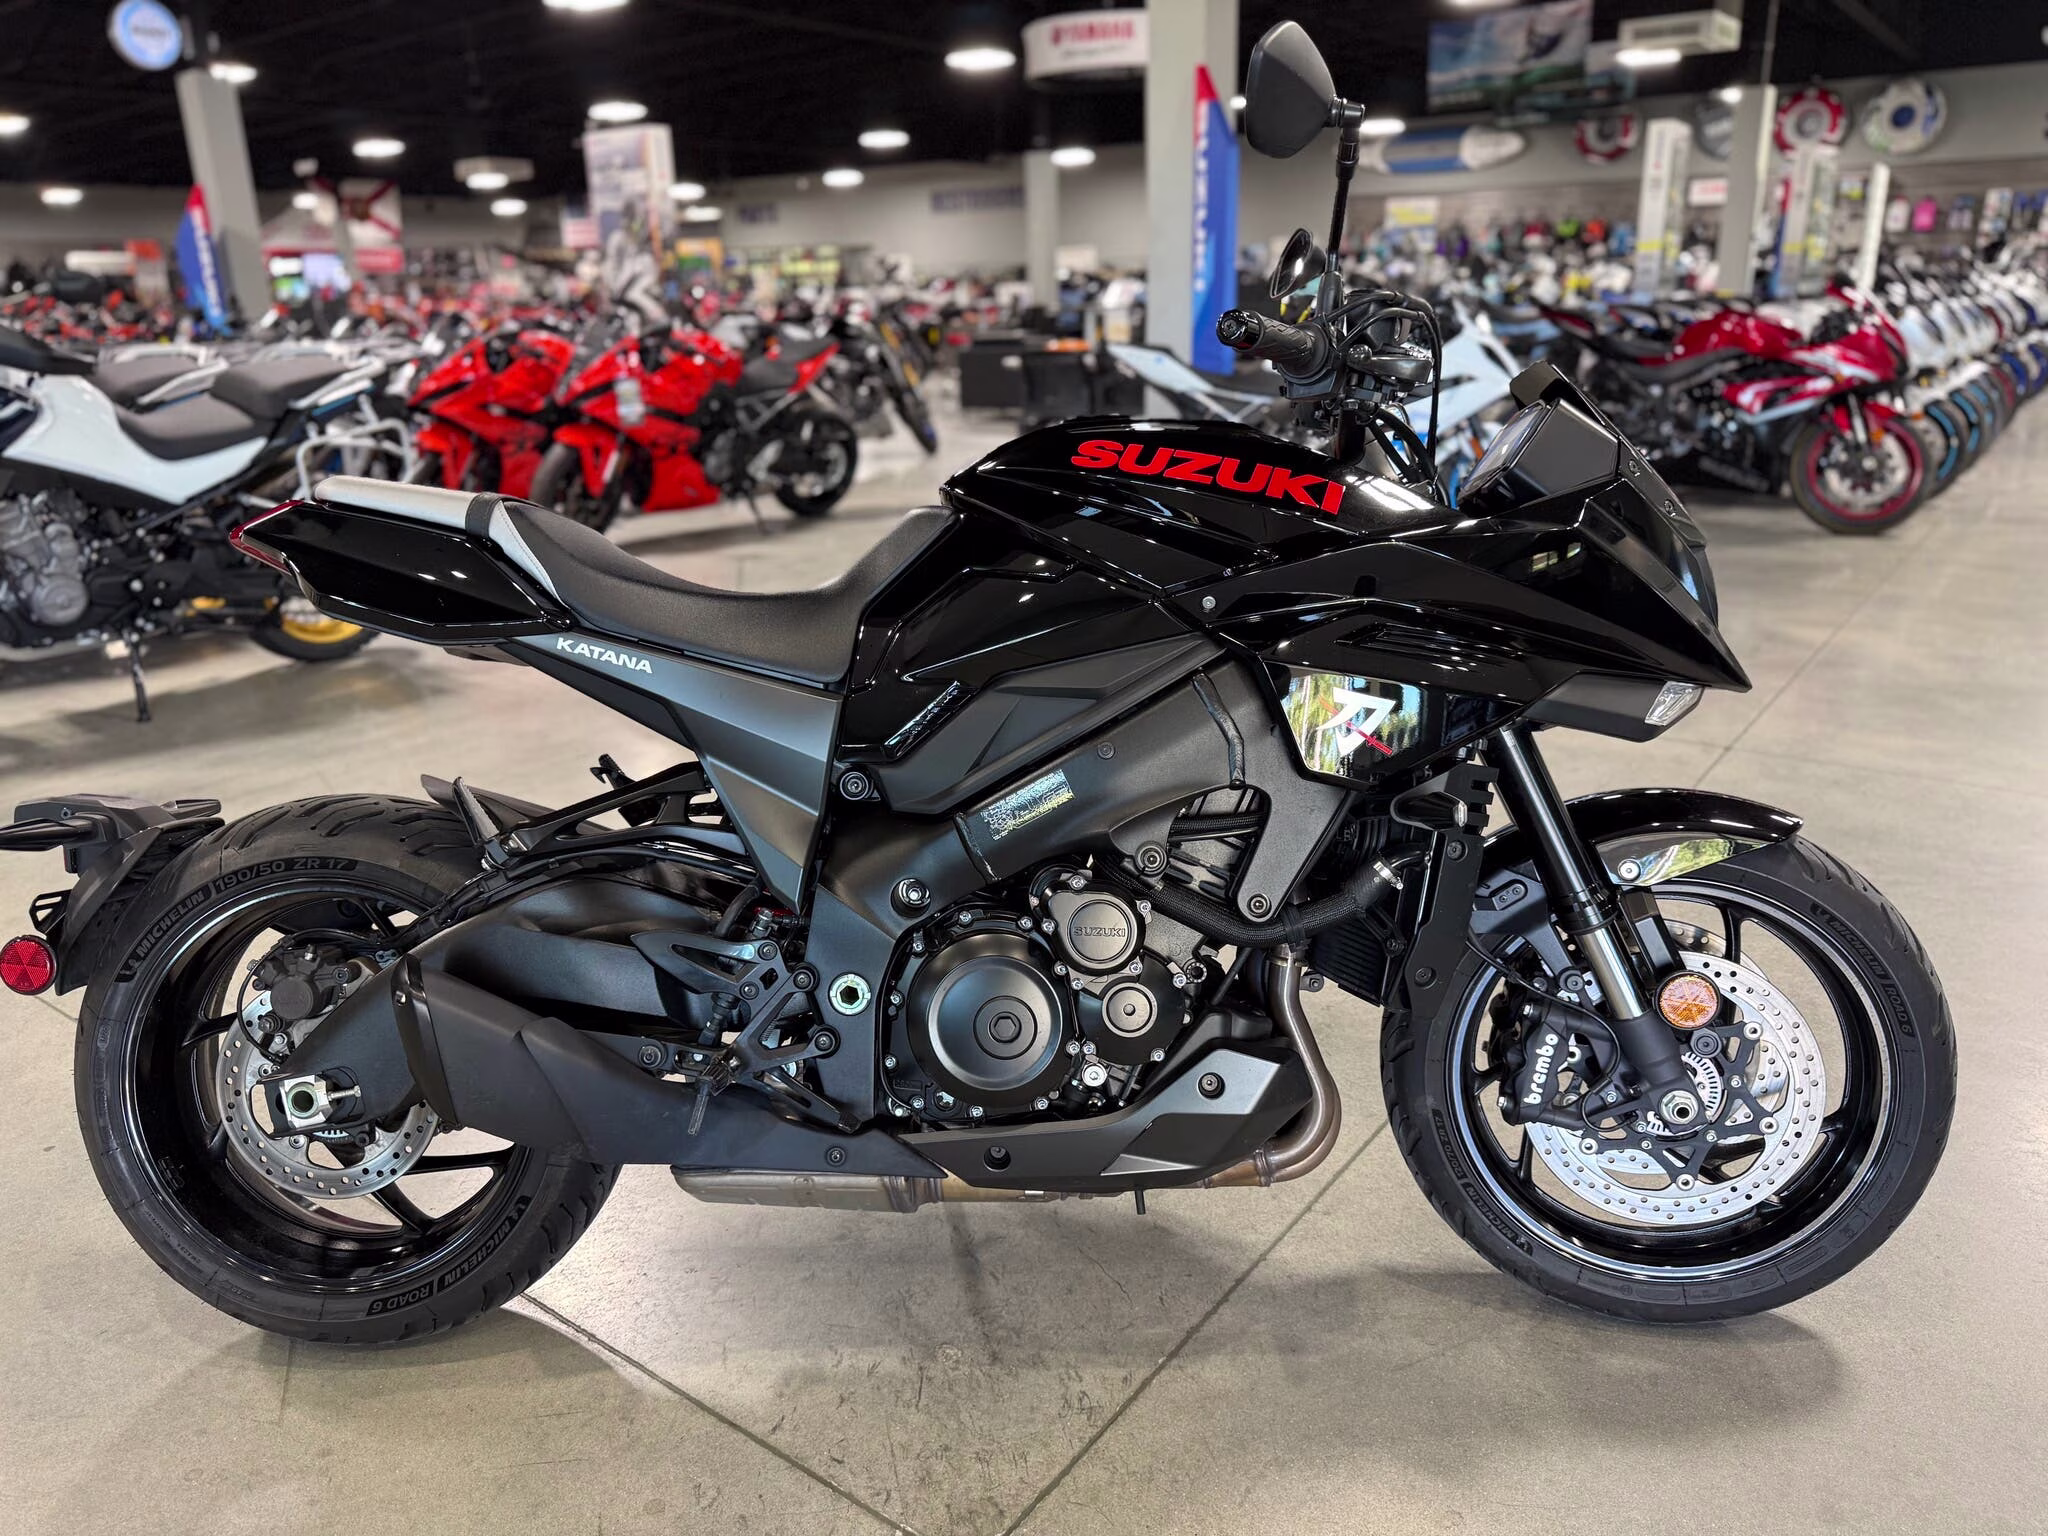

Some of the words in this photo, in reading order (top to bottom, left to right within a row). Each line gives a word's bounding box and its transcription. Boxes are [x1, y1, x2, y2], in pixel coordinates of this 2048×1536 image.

[1071, 440, 1346, 515] SUZUKI
[556, 637, 653, 674] KATANA
[136, 889, 206, 956] MICHELIN
[216, 860, 286, 892] 190/50
[293, 857, 321, 869] ZR
[327, 858, 349, 869] 17
[1073, 926, 1126, 938] SUZUKI
[1829, 919, 1888, 977] MICHELIN
[1884, 983, 1908, 1021] ROAD
[1902, 1024, 1912, 1034] 6
[1523, 1033, 1559, 1105] brembo
[1466, 1185, 1518, 1239] MICHELIN
[444, 1219, 516, 1286] MICHELIN
[371, 1301, 384, 1313] 6
[387, 1285, 431, 1310] ROAD
